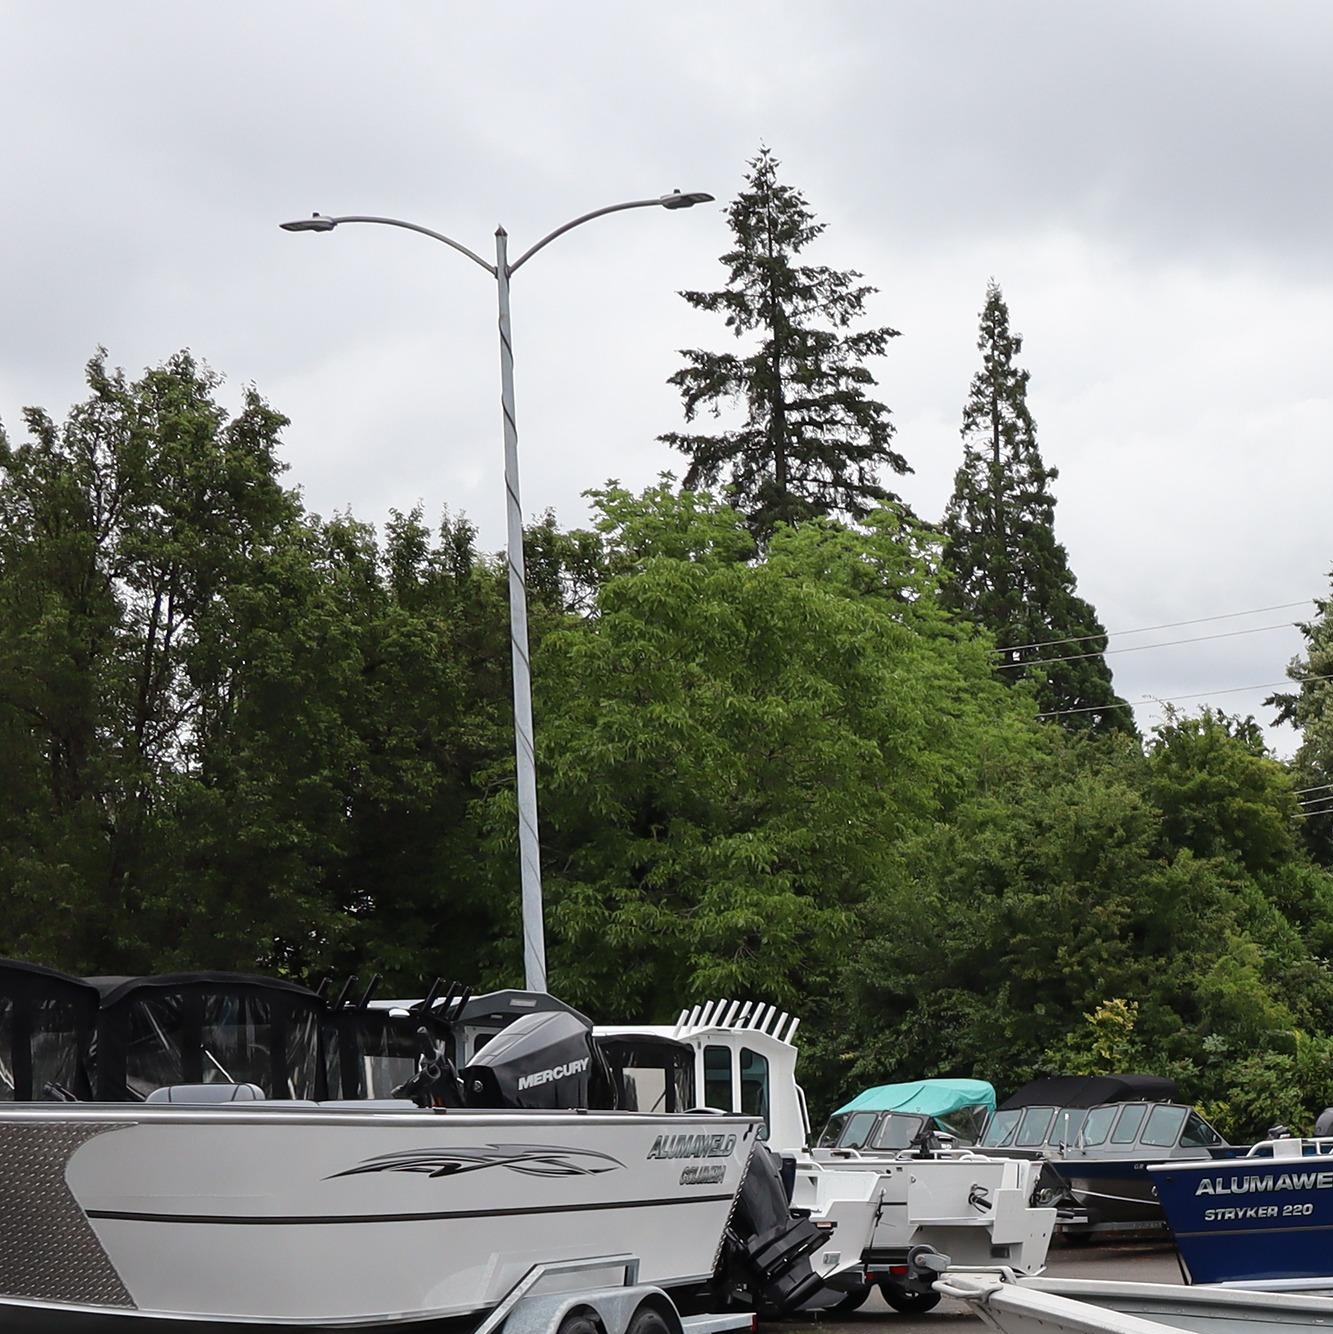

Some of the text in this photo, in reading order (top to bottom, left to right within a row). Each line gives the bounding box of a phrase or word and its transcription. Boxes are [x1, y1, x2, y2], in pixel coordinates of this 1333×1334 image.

[518, 1057, 590, 1090] MERCURY
[646, 1134, 737, 1160] ALUMAWELD
[1204, 1204, 1314, 1222] STRYKER 220
